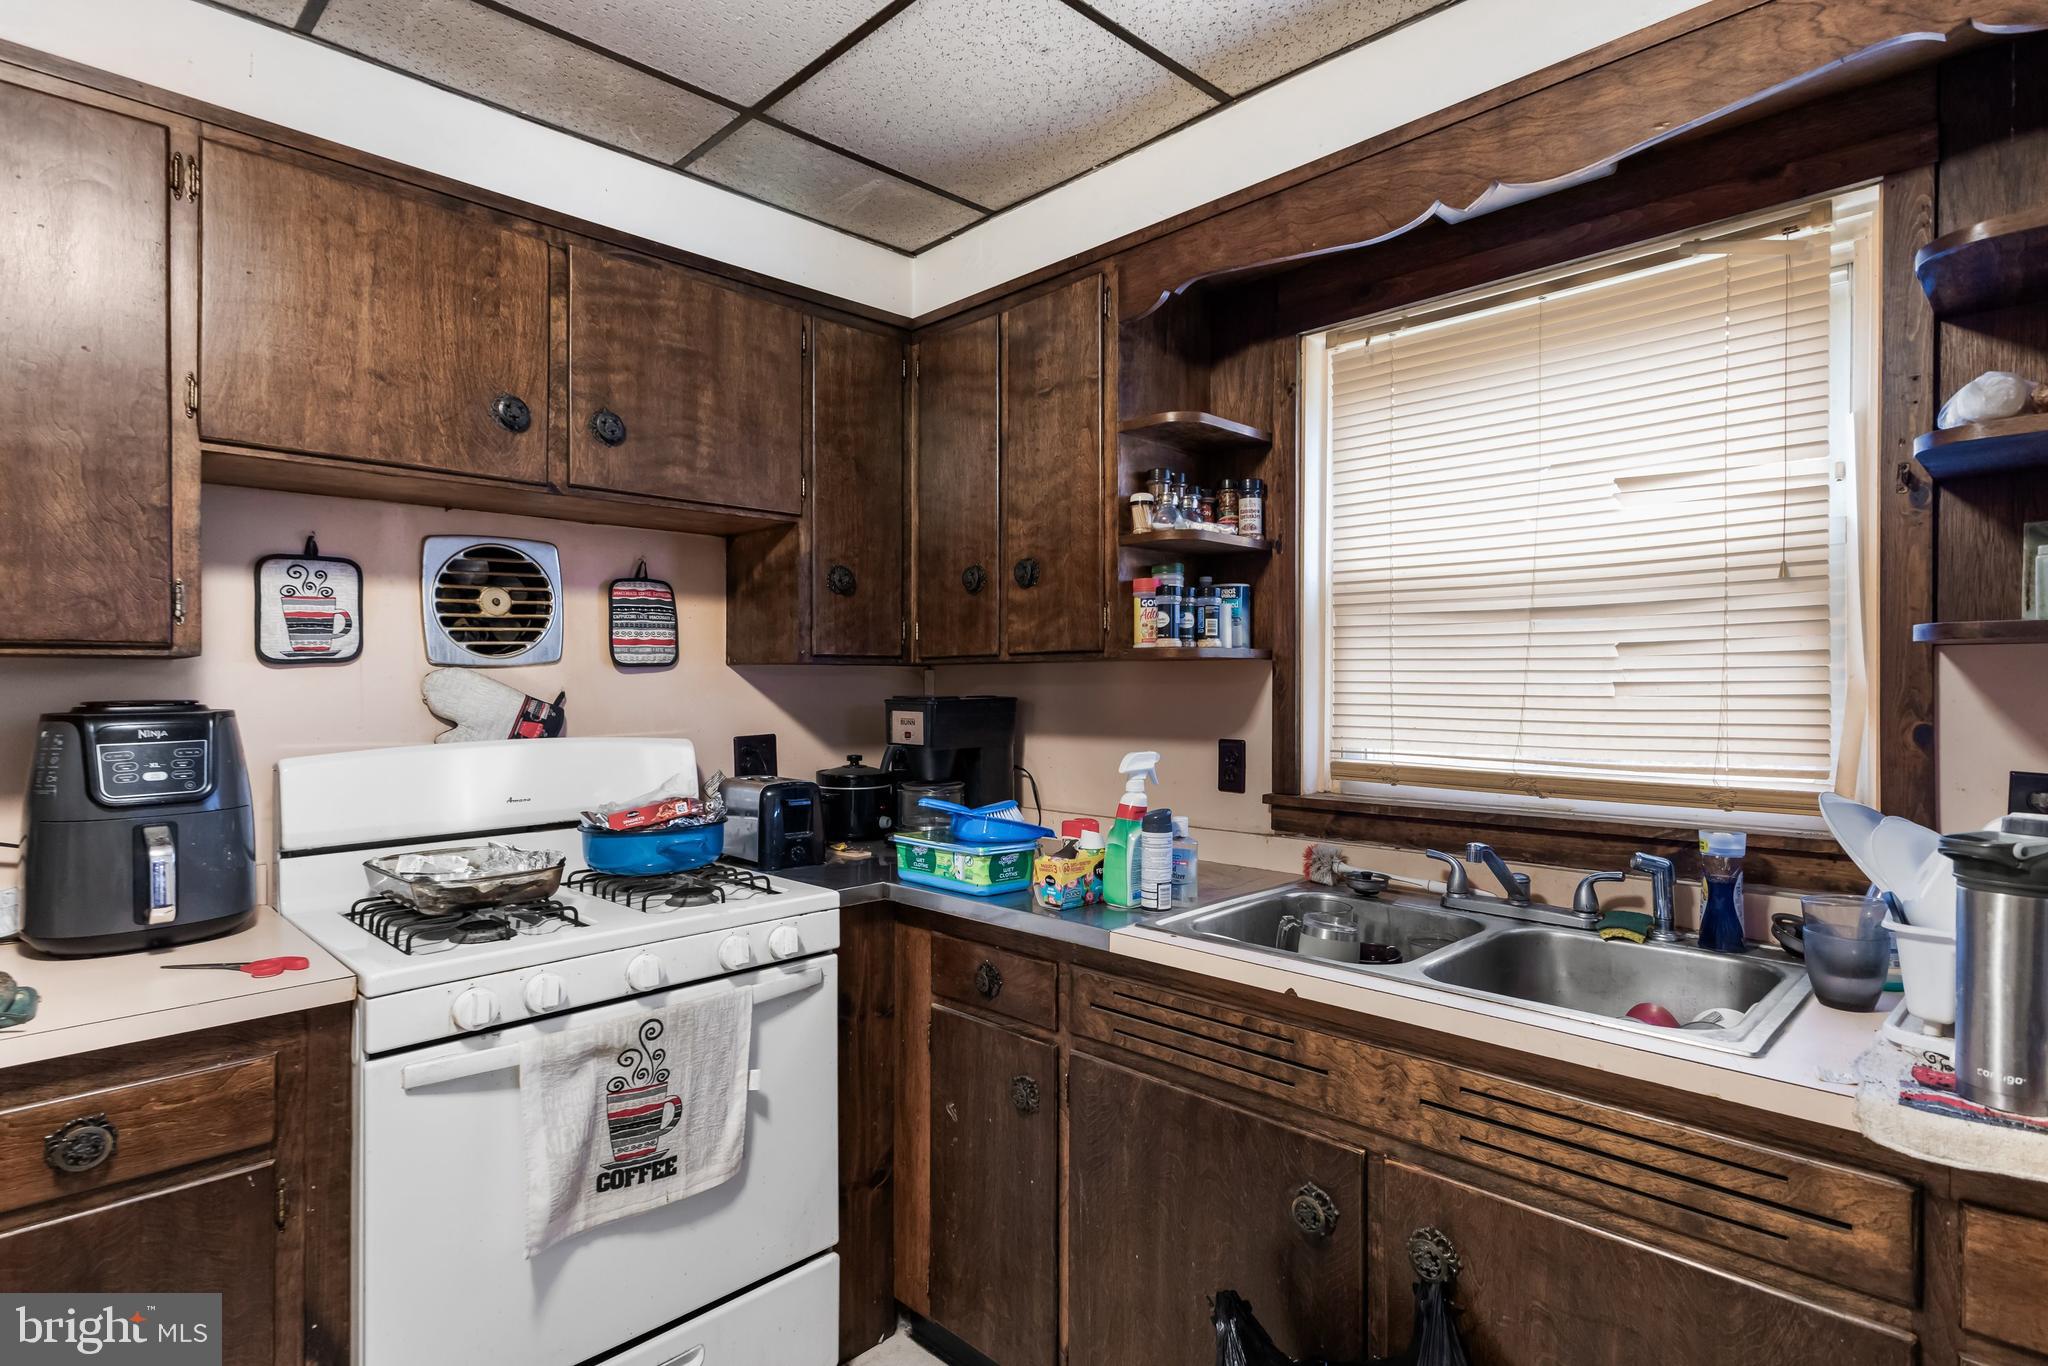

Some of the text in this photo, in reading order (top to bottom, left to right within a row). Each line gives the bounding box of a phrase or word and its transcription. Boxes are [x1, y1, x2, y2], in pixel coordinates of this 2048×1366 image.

[1141, 599, 1158, 607] GO
[1976, 1068, 2023, 1086] coigo
[596, 1155, 678, 1193] COFFEE
